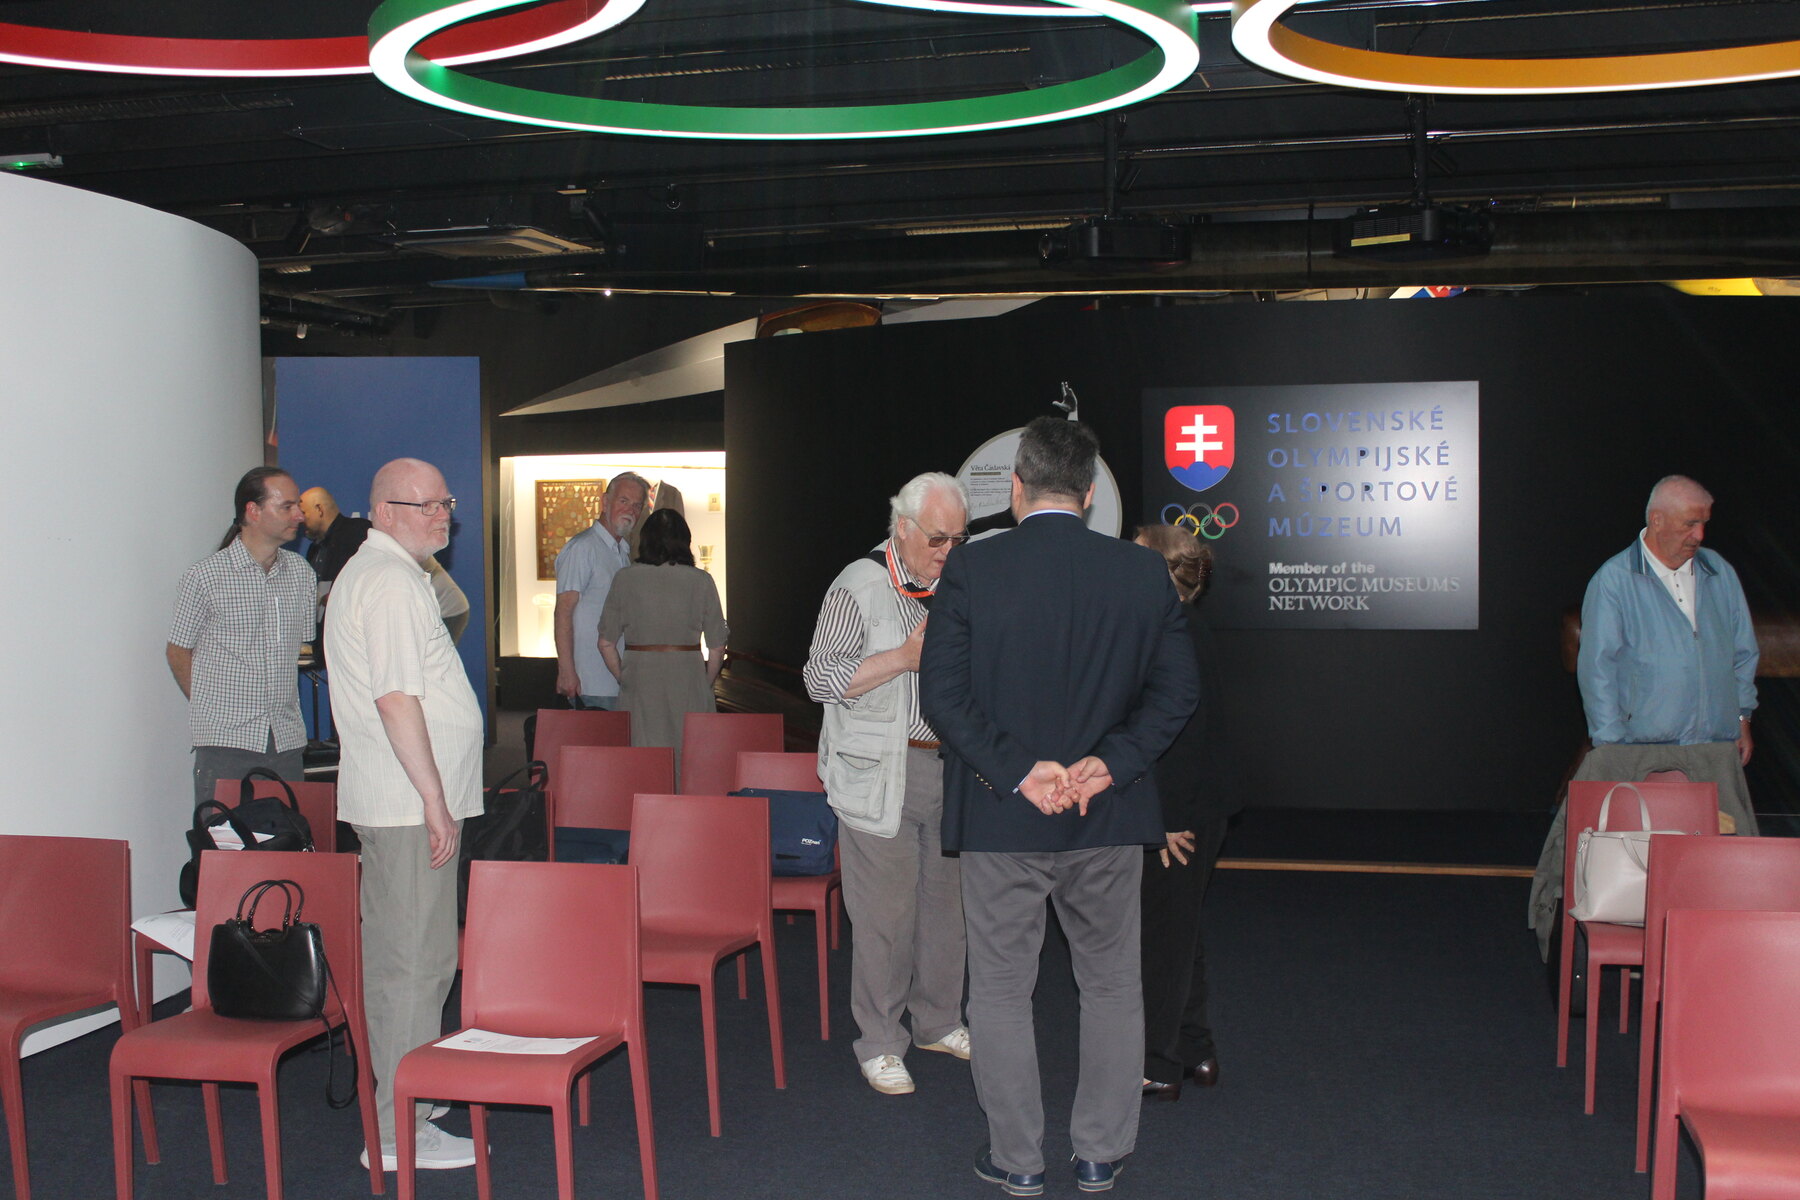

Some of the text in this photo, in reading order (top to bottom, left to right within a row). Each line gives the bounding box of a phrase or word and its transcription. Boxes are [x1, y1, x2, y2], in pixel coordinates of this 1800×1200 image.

[1267, 405, 1444, 433] SLOVENSKÉ
[1267, 440, 1450, 471] OLYMPIJSKÉ
[1268, 475, 1458, 502] A ŠPORTOVÉ
[1268, 512, 1402, 537] MÚZEUM
[1269, 562, 1375, 574] Member of the
[1268, 577, 1460, 593] OLYMPIC MUSEUMS
[1268, 596, 1370, 610] NETWORK
